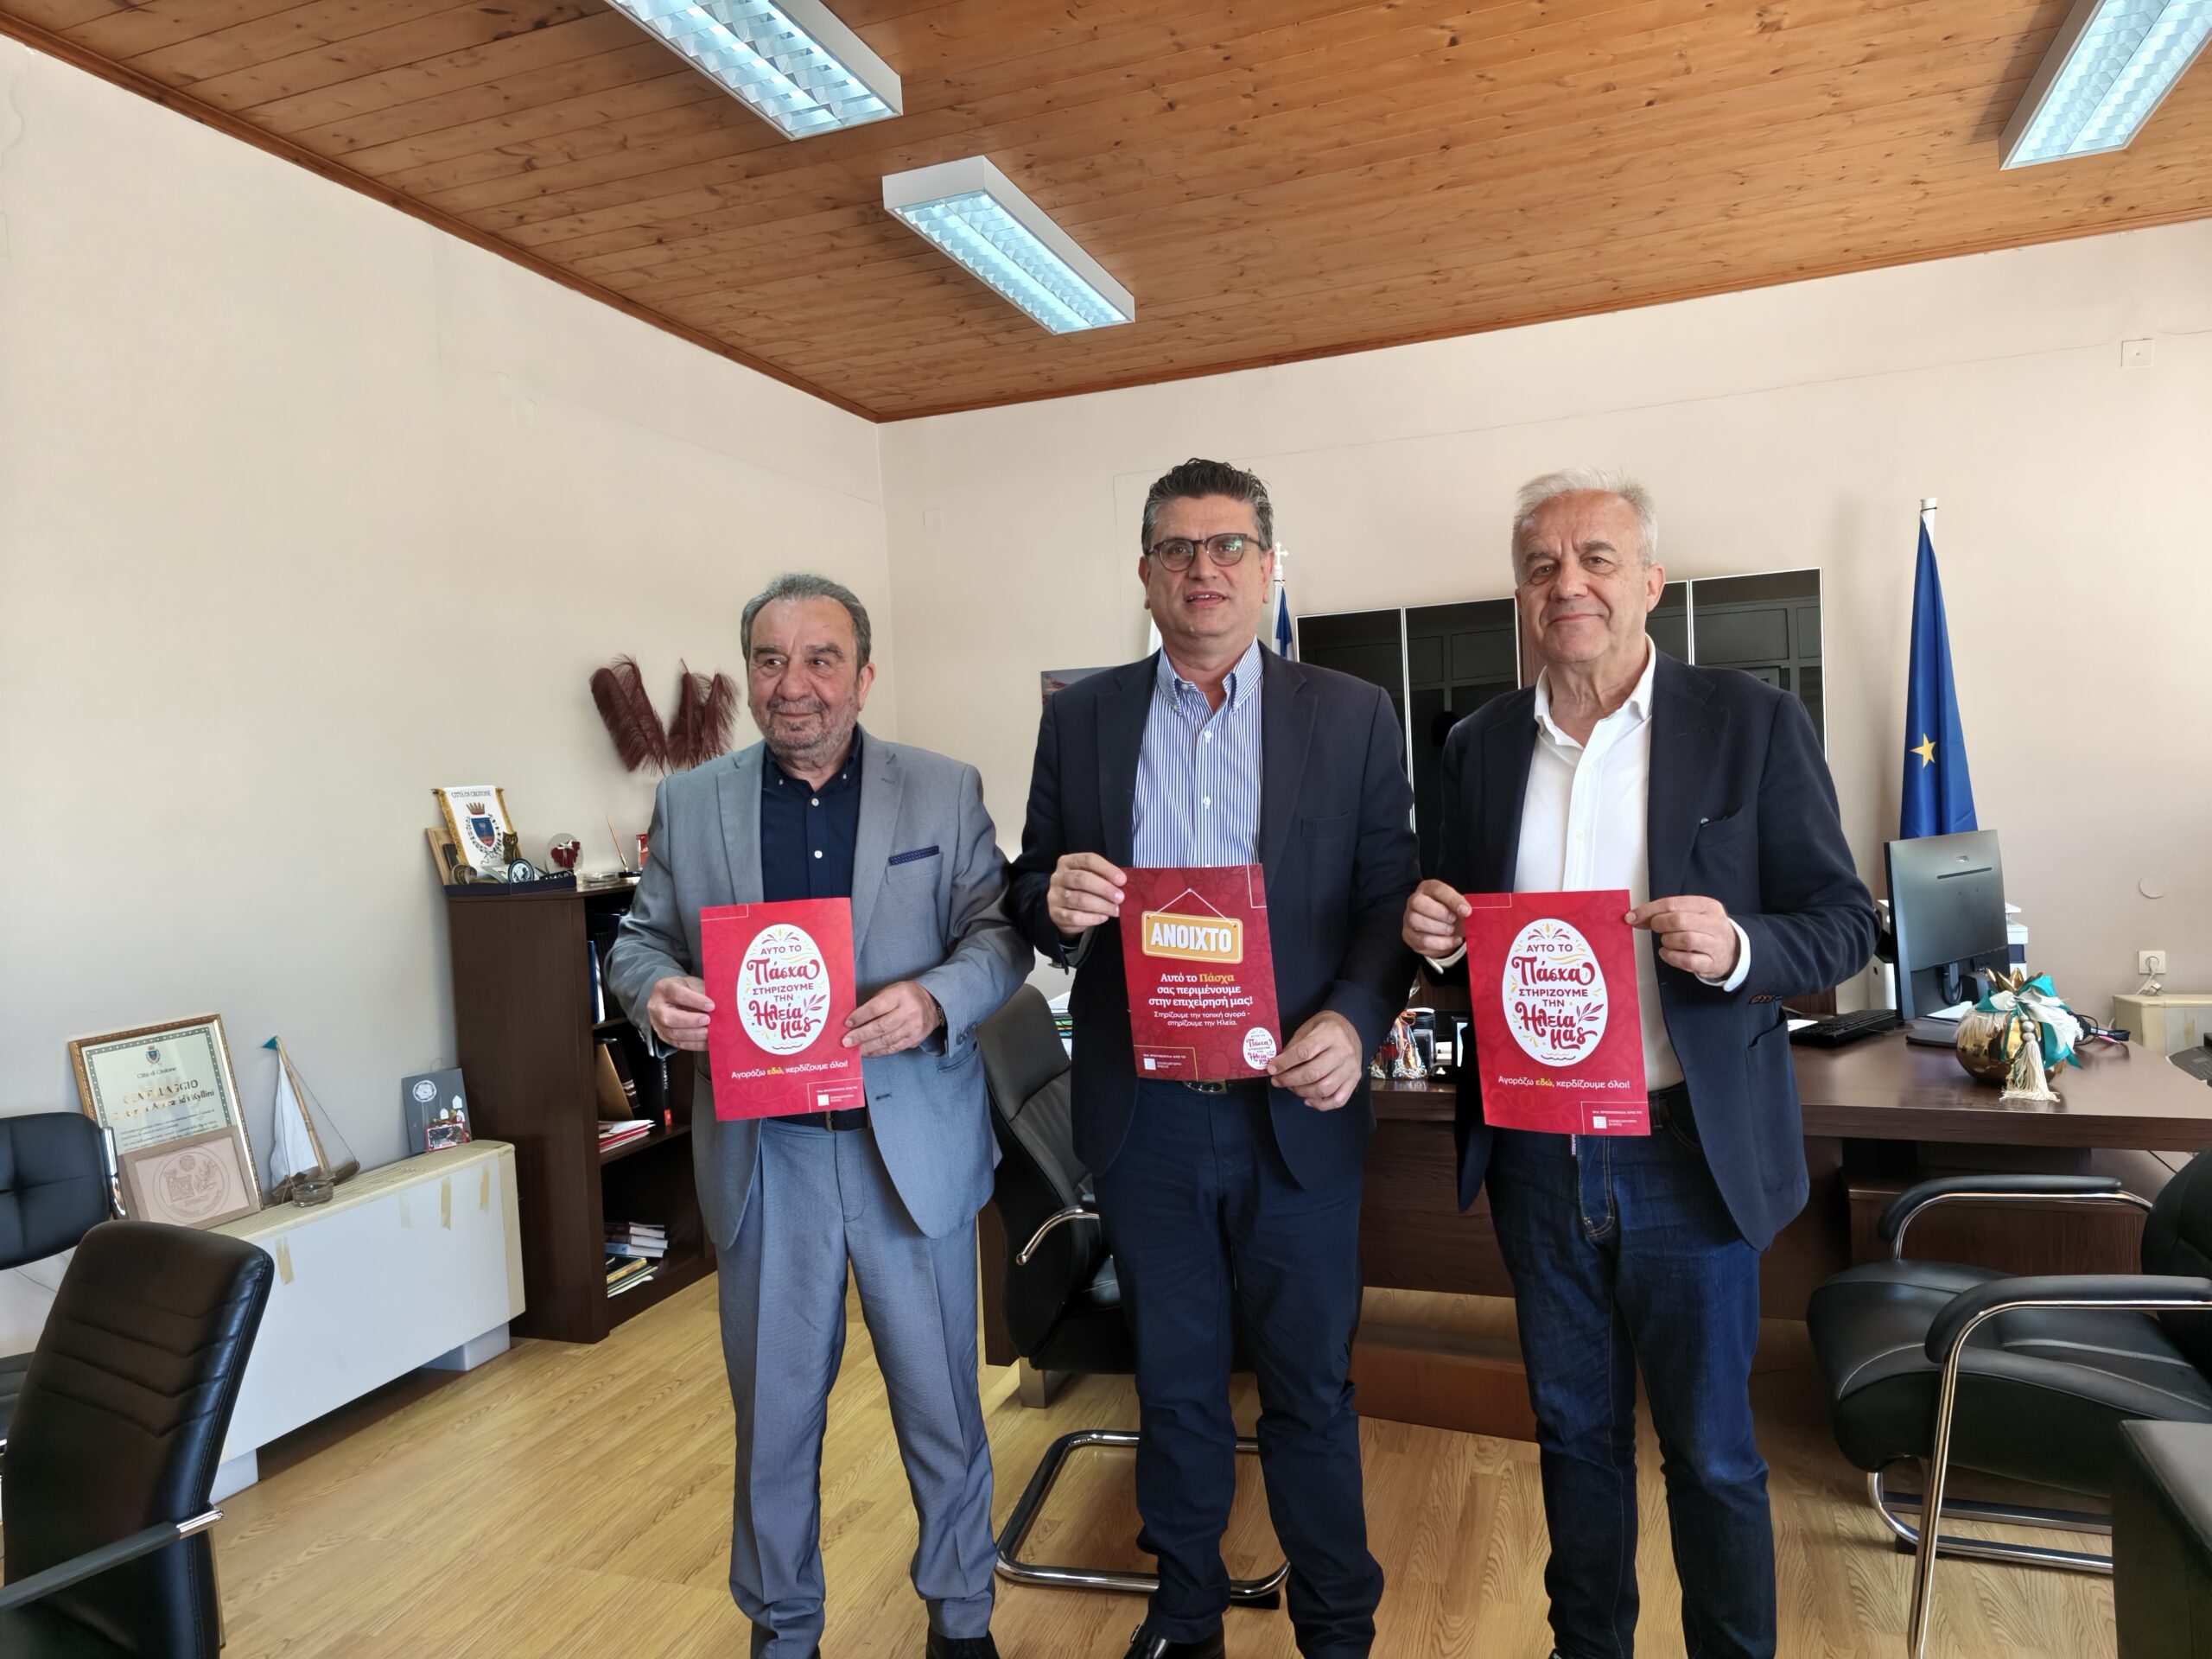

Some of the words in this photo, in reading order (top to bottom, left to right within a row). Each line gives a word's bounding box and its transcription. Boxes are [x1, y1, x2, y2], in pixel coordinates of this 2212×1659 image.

[1150, 922, 1231, 953] ΑΝΟΙΧΤΟ
[760, 946, 786, 955] ΑΥΤΟ
[747, 957, 820, 985] Πάσχα
[1160, 972, 1185, 982] Αυτό
[1198, 972, 1236, 984] Πάσχα
[1511, 956, 1595, 986] Πάσχα
[753, 983, 814, 995] ΣΤΗΡΙΖΟΥΜΕ
[1157, 986, 1175, 995] σας
[1176, 984, 1241, 996] περιμένουμε
[1519, 988, 1588, 997] ΣΤΗΡΙΖΟΥΜΕ
[1148, 997, 1172, 1007] στην
[1173, 995, 1229, 1008] επιχείρησή
[1230, 995, 1253, 1007] μας!
[748, 1000, 804, 1030] Ηλεία
[1224, 1010, 1246, 1019] αγορά
[1515, 1001, 1576, 1037] Ηλεία
[780, 1016, 821, 1039] μας
[1550, 1027, 1598, 1050] μας
[731, 1068, 766, 1079] Αγοράζω
[766, 1066, 785, 1075] εδώ,
[785, 1064, 828, 1074] κερδίζουμε
[1498, 1076, 1534, 1086] Αγοράζω
[1535, 1077, 1554, 1088] εδώ,
[1556, 1078, 1605, 1089] κερδίζουμε
[1607, 1080, 1630, 1089] όλοι!
